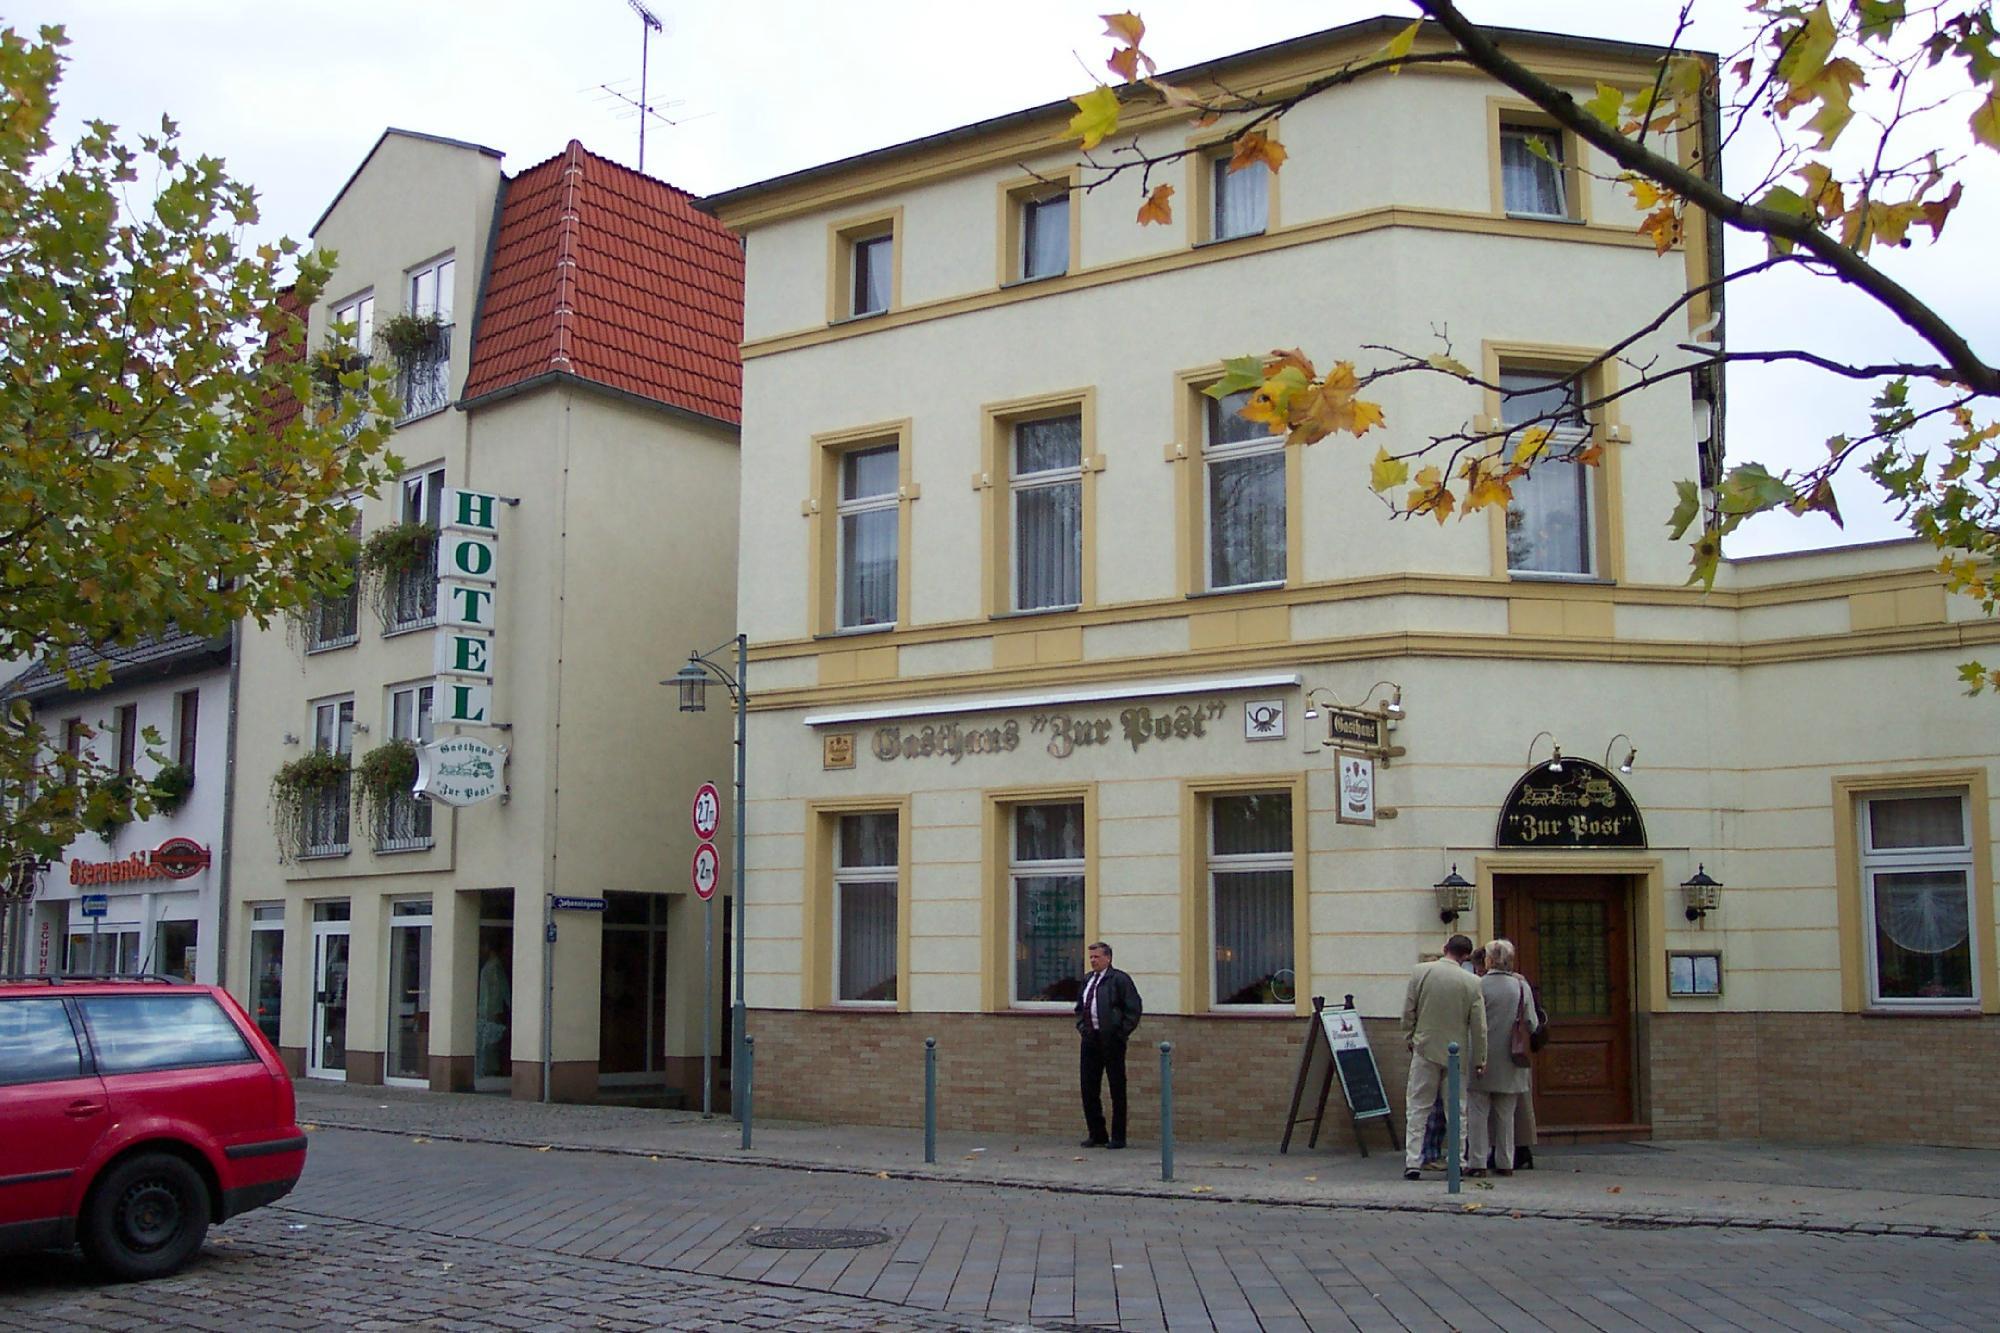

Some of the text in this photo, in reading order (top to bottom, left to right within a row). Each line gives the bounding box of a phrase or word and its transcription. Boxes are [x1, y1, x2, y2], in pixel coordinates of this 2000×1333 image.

[451, 490, 496, 721] HOTEL
[872, 719, 1020, 766] Gasthaus
[1333, 714, 1376, 740] Gasthaus
